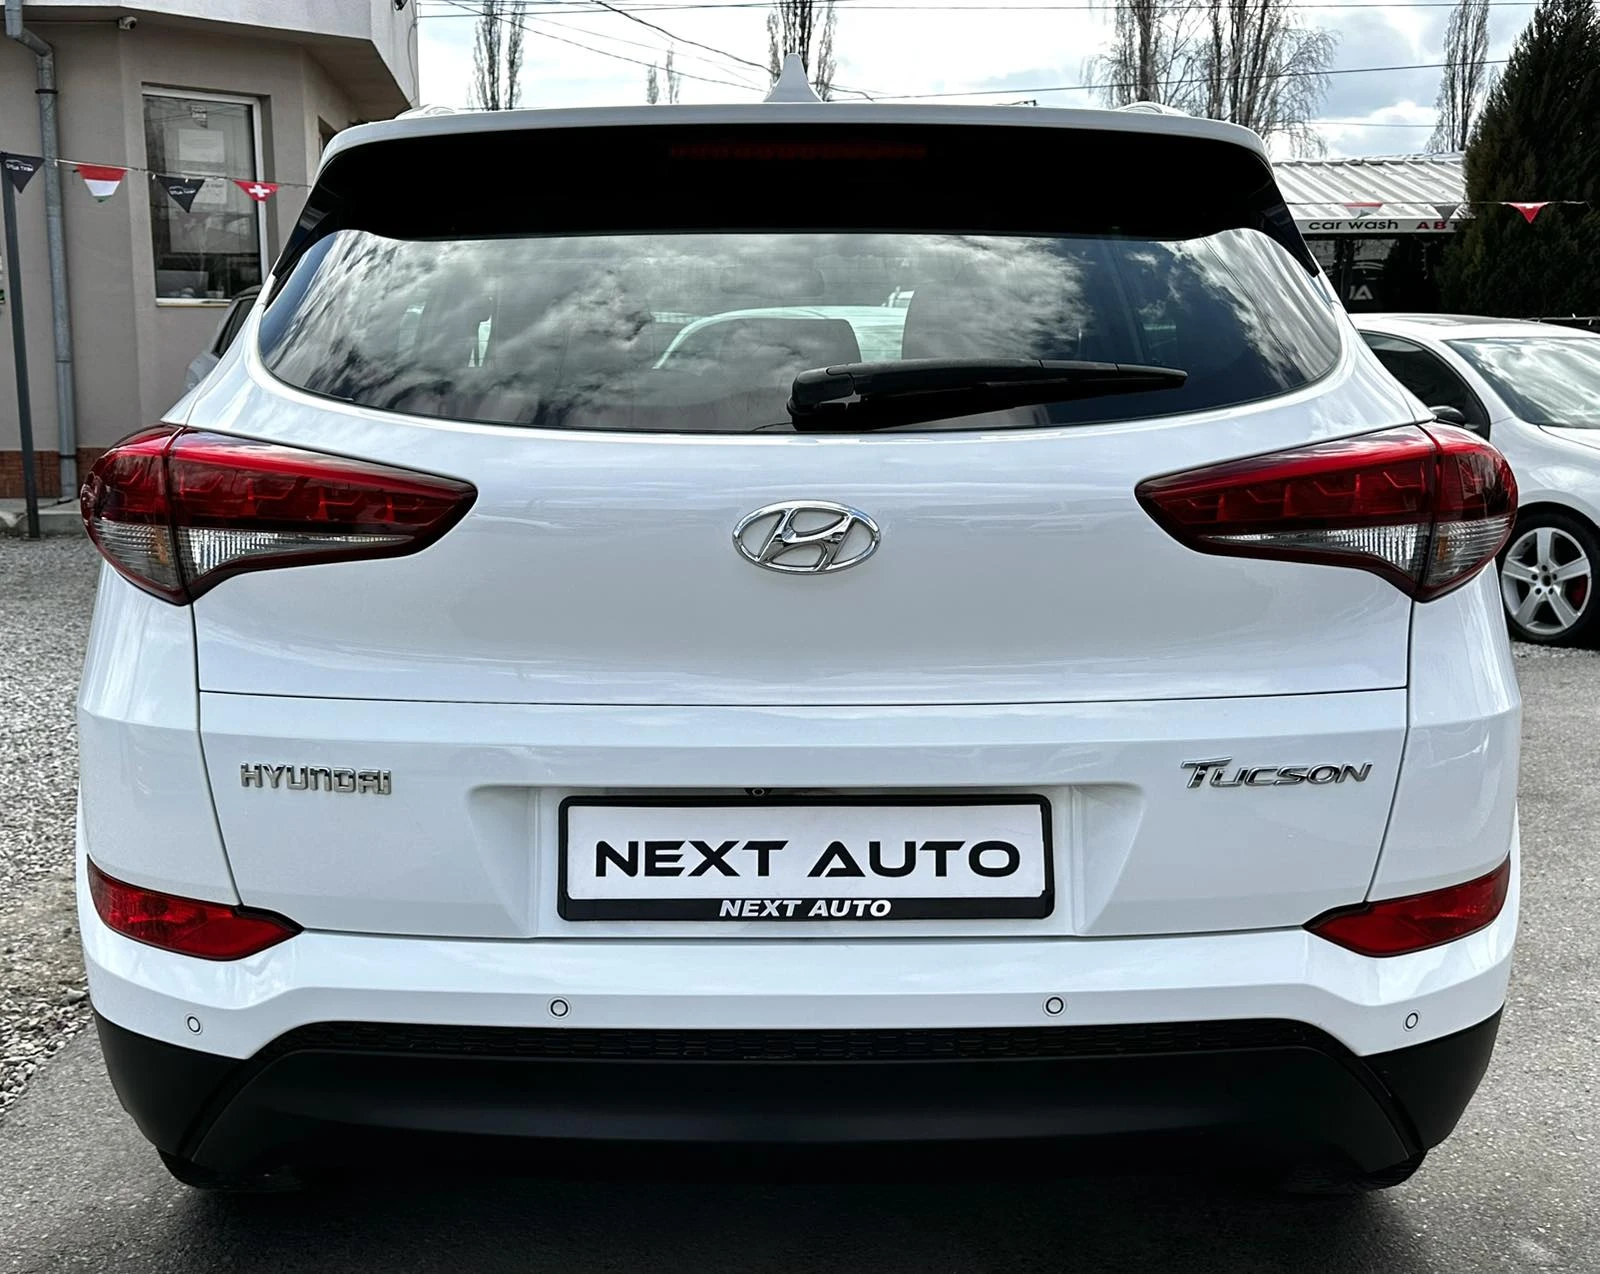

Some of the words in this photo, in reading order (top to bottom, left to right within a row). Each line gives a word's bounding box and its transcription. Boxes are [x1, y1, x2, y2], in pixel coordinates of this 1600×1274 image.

[1308, 221, 1341, 230] car
[1348, 219, 1398, 230] wash
[240, 760, 392, 796] HYUNDAI
[1180, 755, 1374, 789] TUCSON
[594, 840, 789, 878] NEXT
[806, 840, 1021, 878] AUTO
[718, 899, 803, 918] NEXT
[806, 899, 892, 918] AUTO
